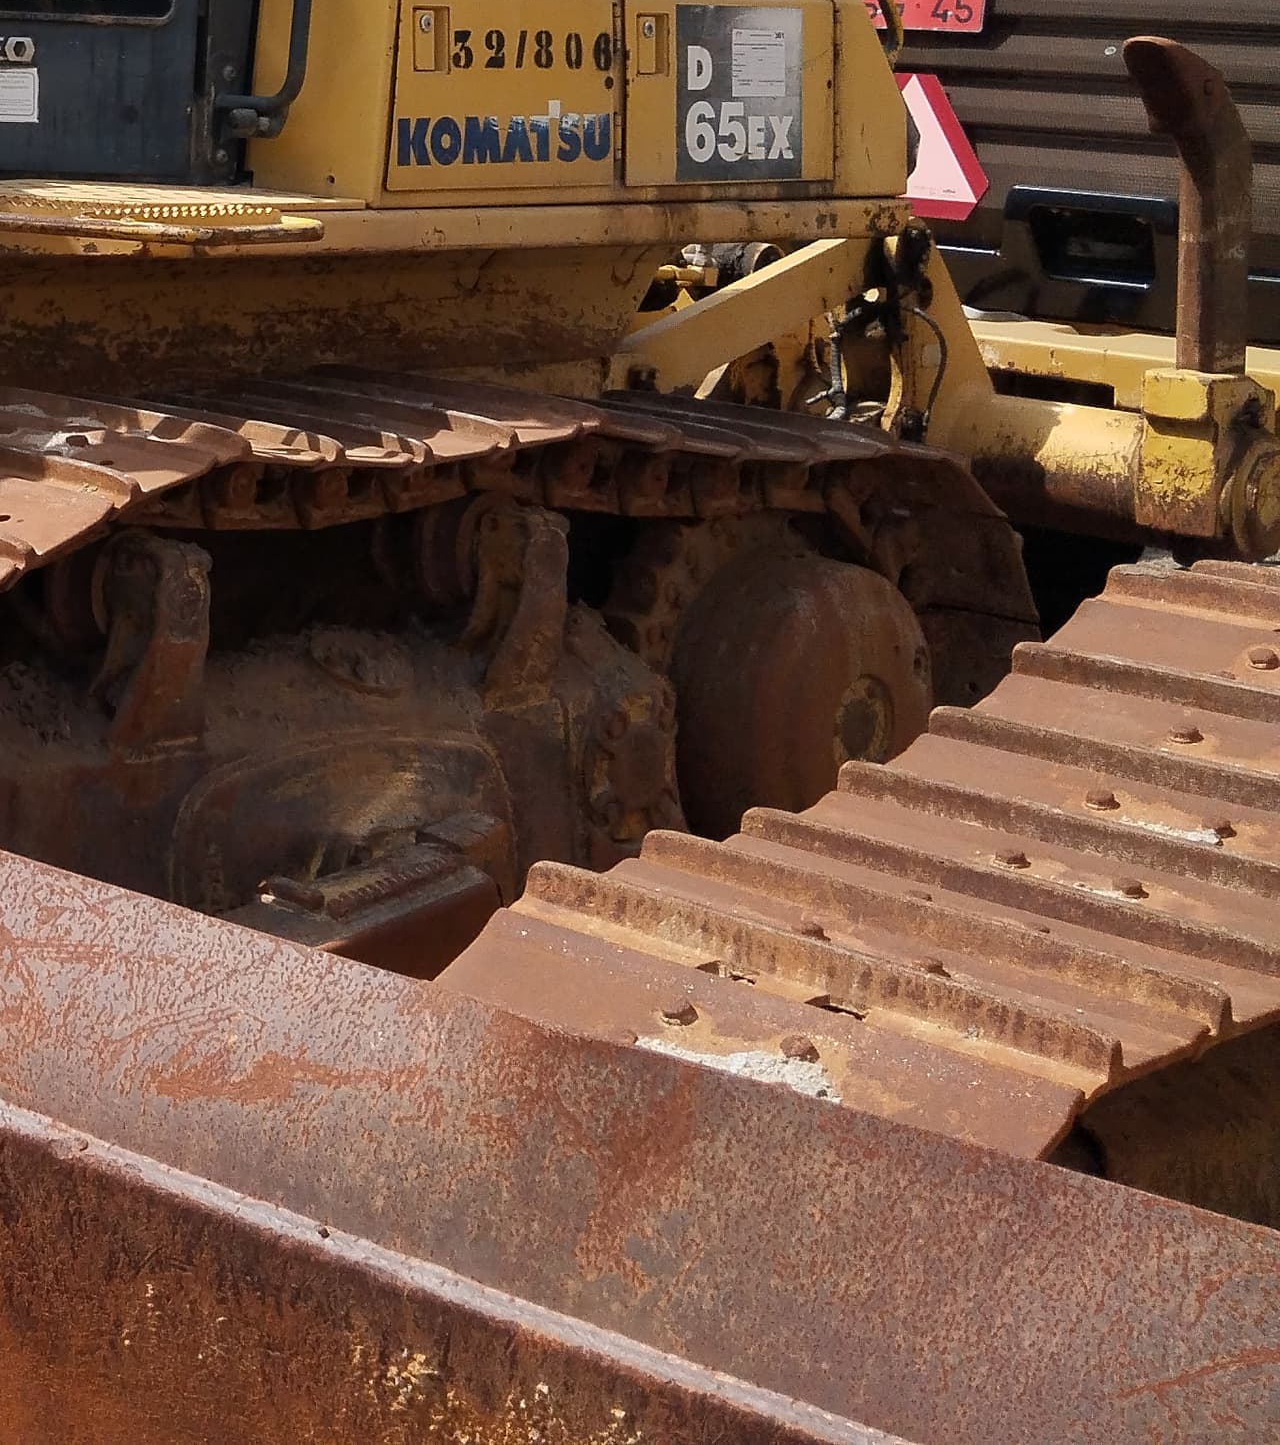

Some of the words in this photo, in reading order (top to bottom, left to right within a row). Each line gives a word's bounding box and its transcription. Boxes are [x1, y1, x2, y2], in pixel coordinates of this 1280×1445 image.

[687, 44, 713, 91] D
[397, 99, 611, 167] KOMATSU
[685, 100, 795, 163] 65EX
